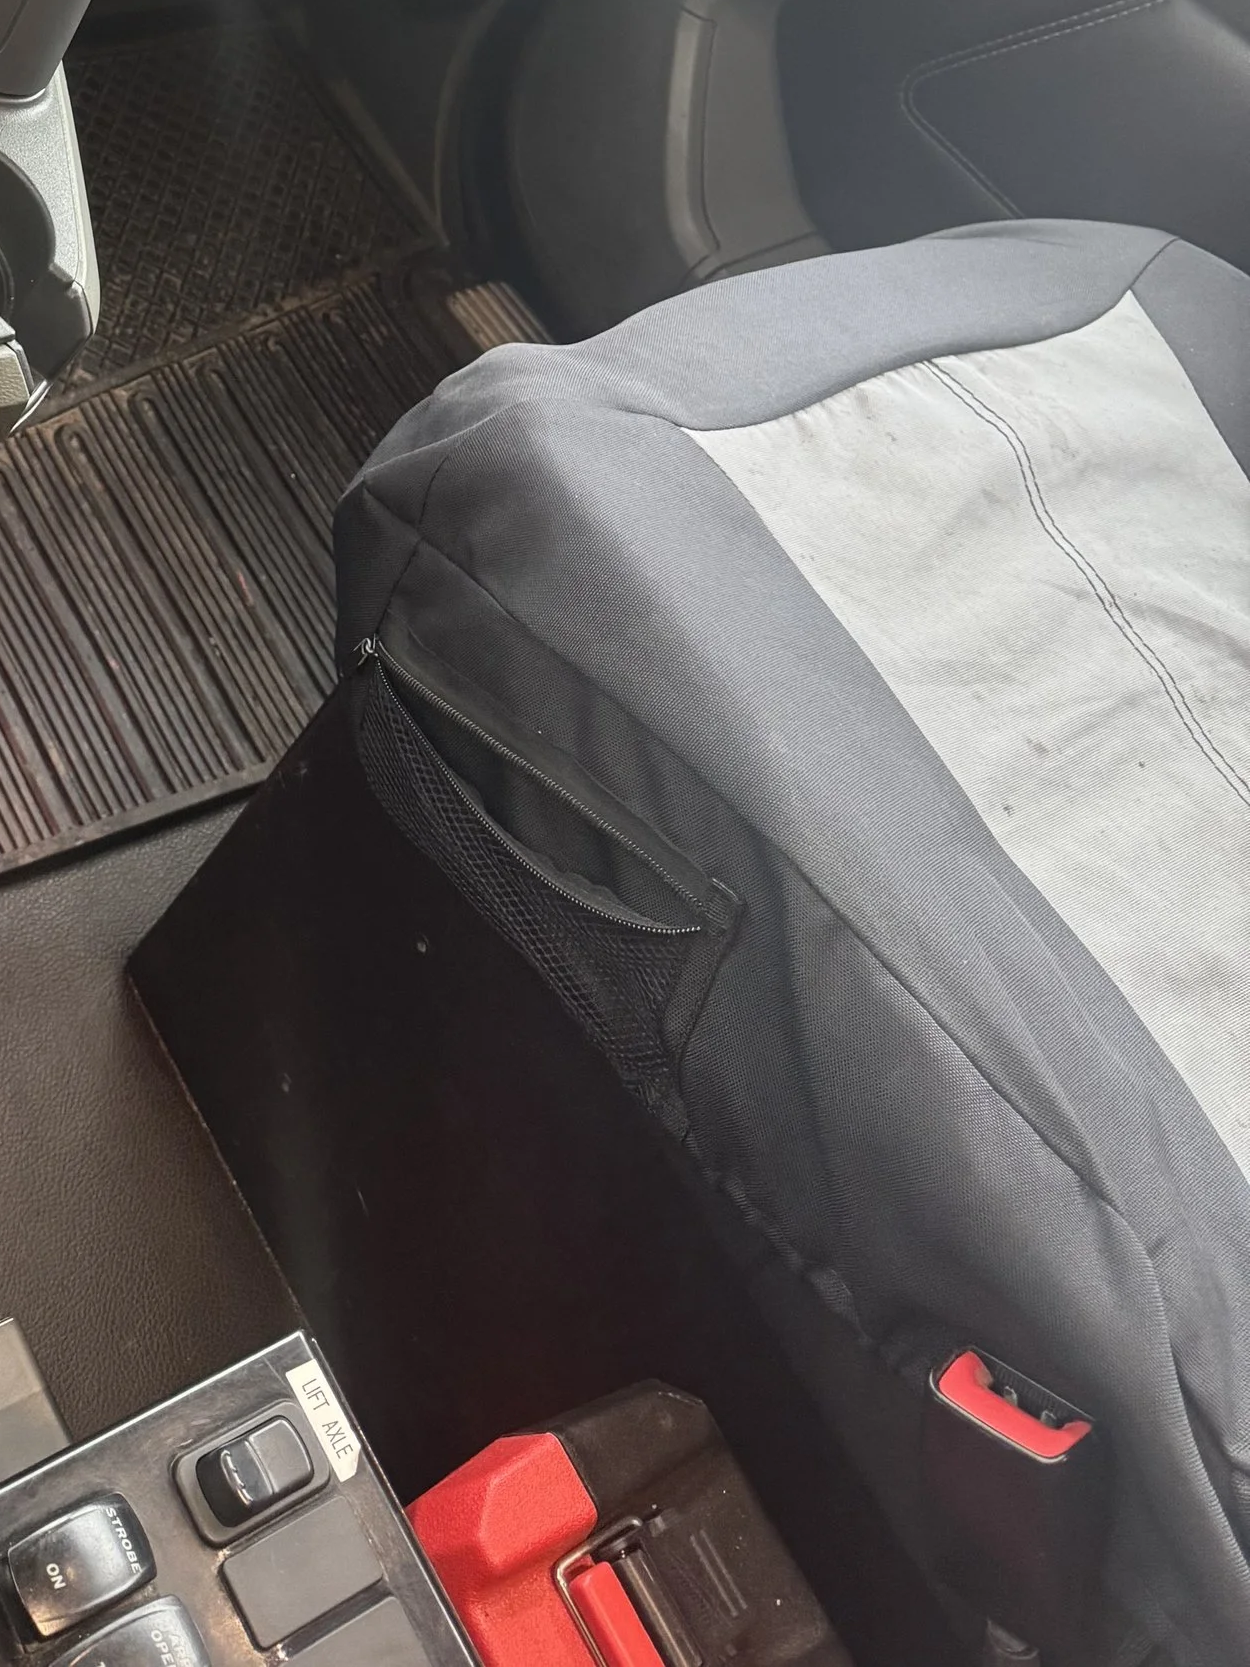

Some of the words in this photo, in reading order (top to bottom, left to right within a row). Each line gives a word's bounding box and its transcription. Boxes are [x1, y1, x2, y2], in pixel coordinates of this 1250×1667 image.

[301, 1378, 330, 1411] LIFT
[322, 1420, 354, 1459] AXLE
[105, 1507, 142, 1574] STROBE
[46, 1563, 66, 1589] ON
[151, 1629, 177, 1667] OPE
